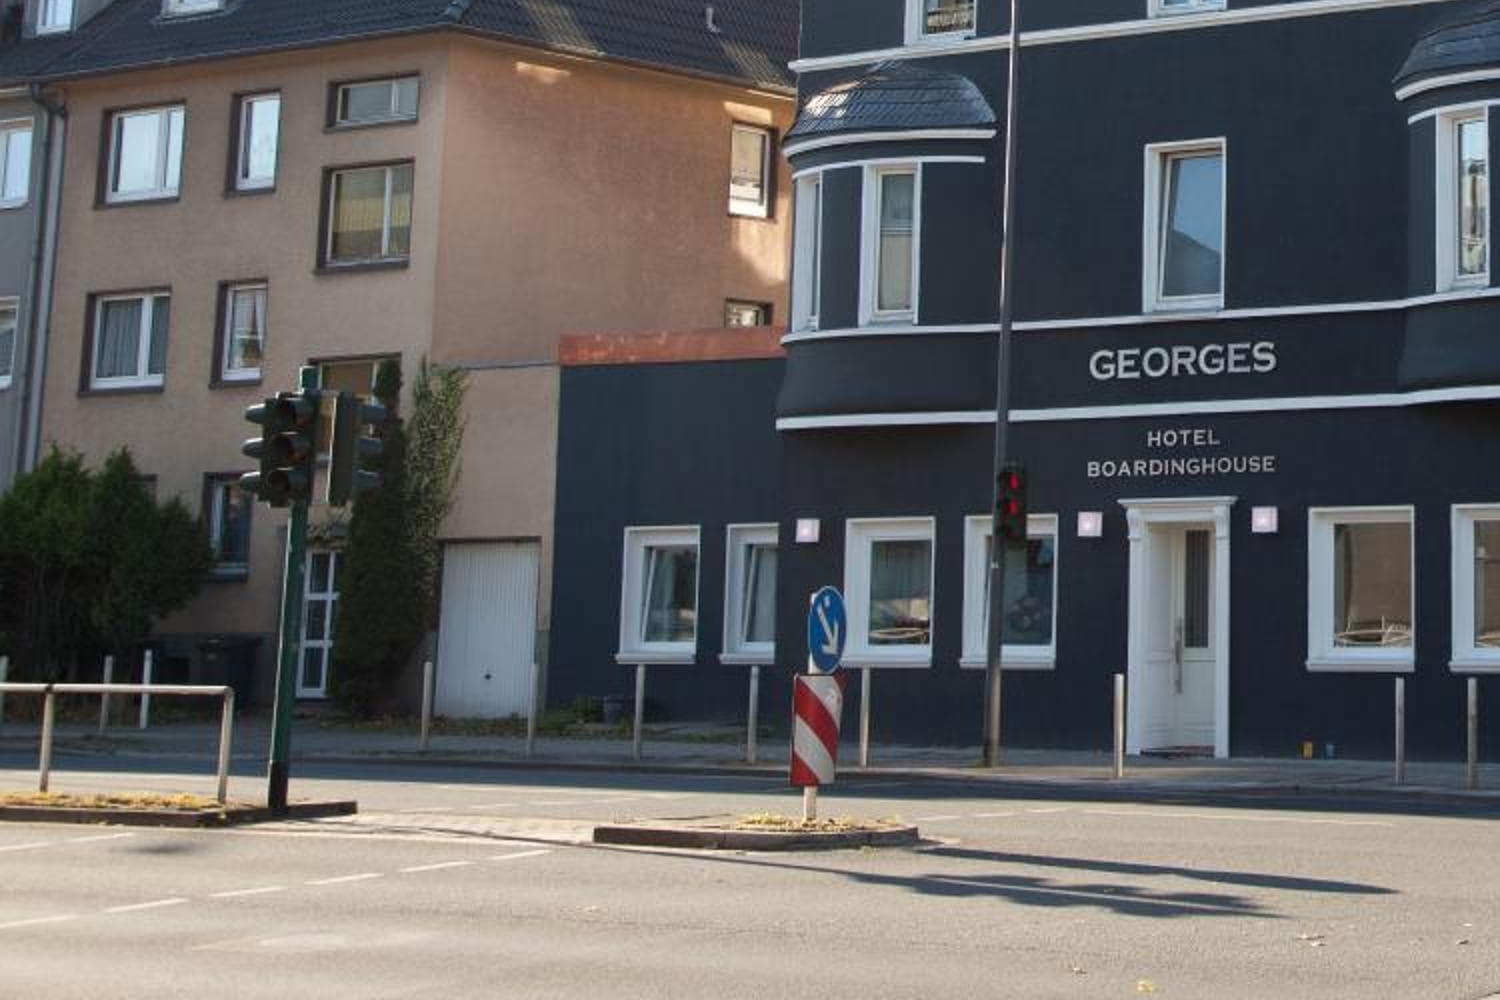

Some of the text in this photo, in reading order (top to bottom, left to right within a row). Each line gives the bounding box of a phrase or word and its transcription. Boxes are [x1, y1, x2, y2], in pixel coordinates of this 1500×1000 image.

[1089, 341, 1277, 380] GEORGES
[1147, 429, 1220, 447] HOTEL
[1087, 456, 1275, 477] BOARDINGHOUSE
